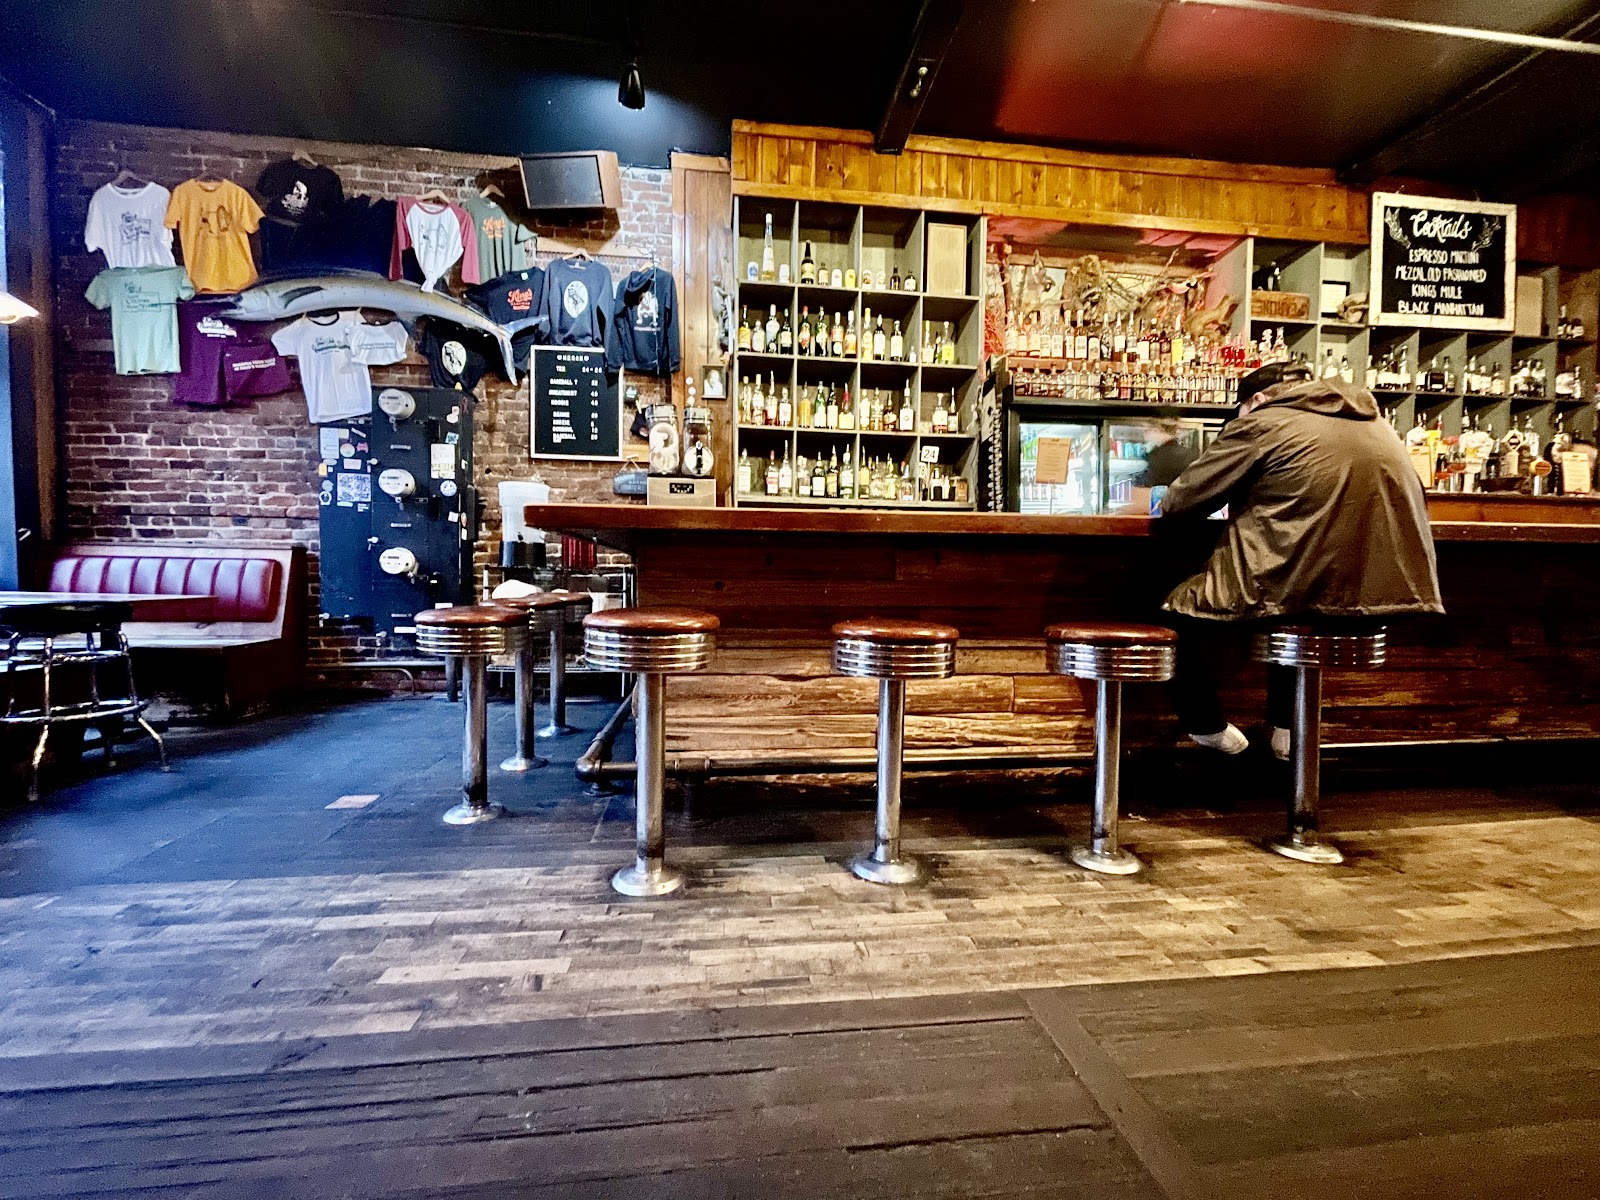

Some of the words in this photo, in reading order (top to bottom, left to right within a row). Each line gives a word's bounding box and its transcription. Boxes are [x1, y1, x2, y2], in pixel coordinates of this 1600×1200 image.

[1410, 210, 1473, 243] Cocktails
[1408, 248, 1448, 264] ESPRESSO
[1395, 265, 1427, 282] MEZCAL
[1427, 267, 1442, 282] OLD
[1442, 267, 1487, 283] FASHIONED
[1411, 284, 1437, 298] KINGS
[1440, 286, 1462, 299] MULE
[1397, 300, 1429, 314] BLACK
[1434, 302, 1484, 316] MANHATTAN
[923, 449, 936, 459] 24
